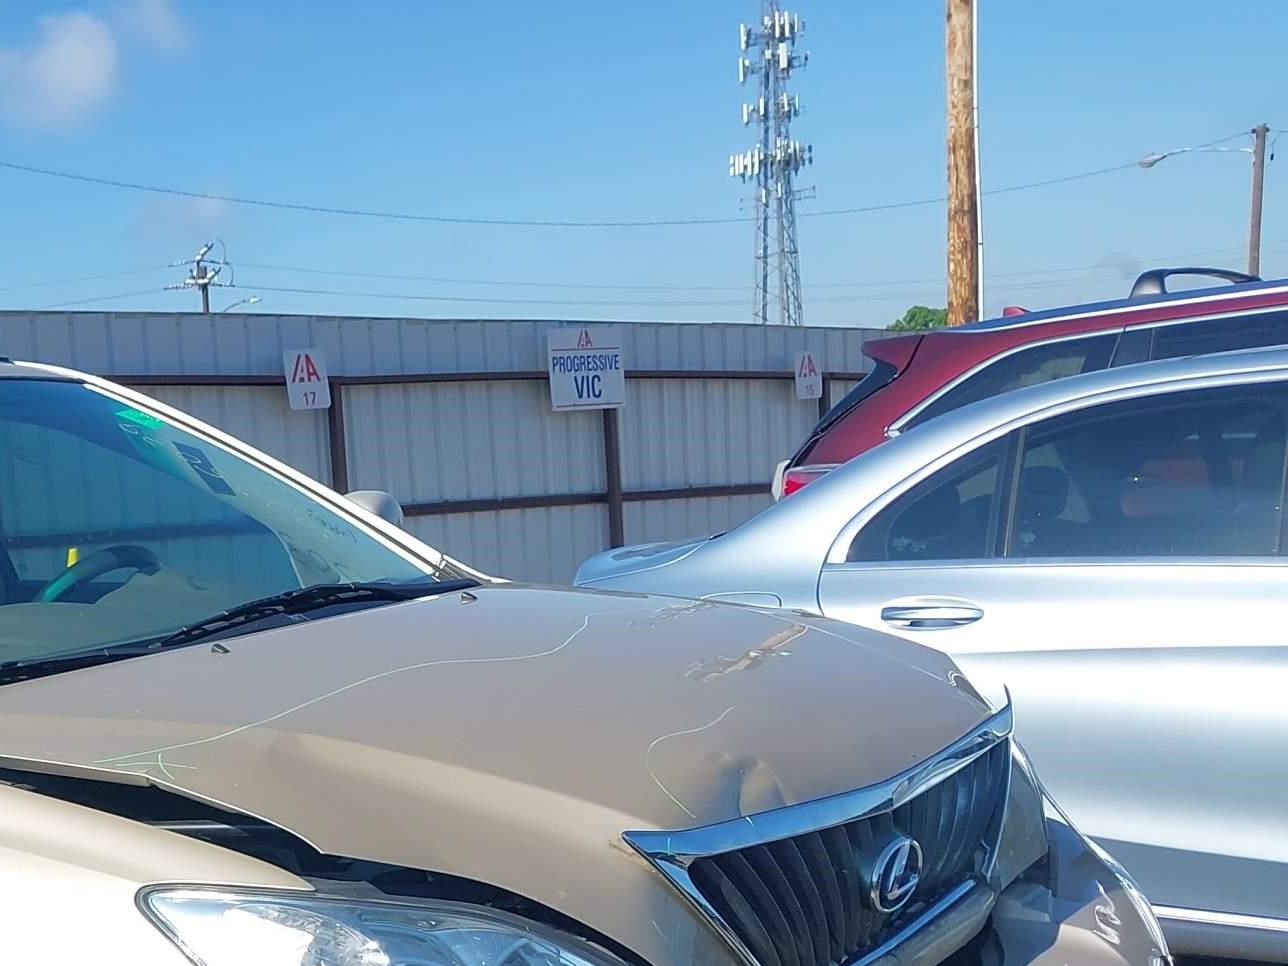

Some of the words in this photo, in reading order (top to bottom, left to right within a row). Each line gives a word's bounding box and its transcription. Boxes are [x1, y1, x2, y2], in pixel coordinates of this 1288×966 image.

[552, 354, 620, 374] PROGRESSIVE
[573, 374, 602, 399] VIC
[303, 391, 316, 406] 17
